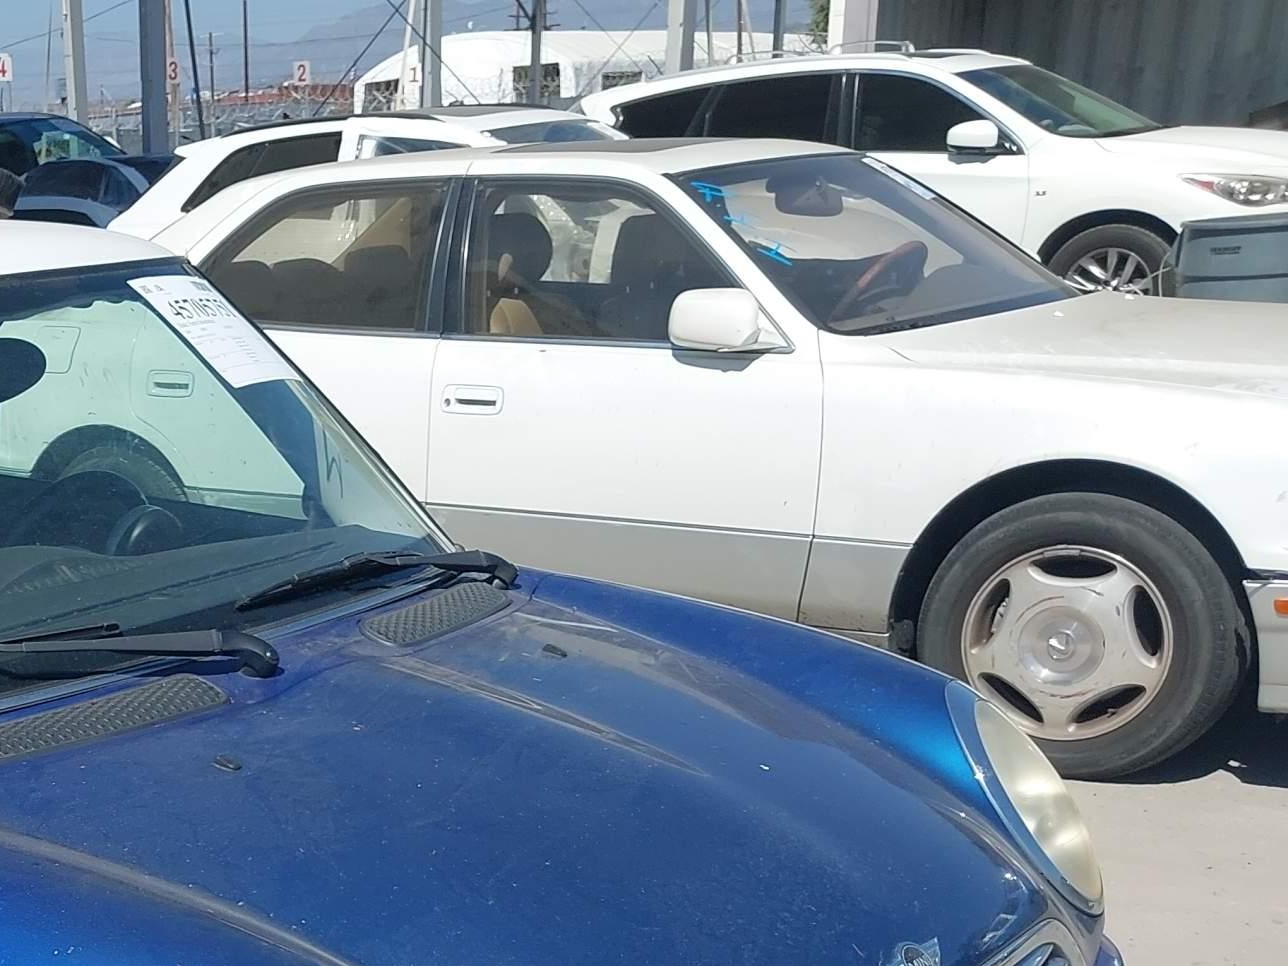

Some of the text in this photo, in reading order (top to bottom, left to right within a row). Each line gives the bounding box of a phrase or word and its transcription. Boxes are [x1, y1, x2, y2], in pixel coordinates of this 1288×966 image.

[168, 61, 178, 81] 3
[297, 64, 307, 82] 2
[409, 66, 419, 83] 1
[167, 298, 238, 321] 45705751
